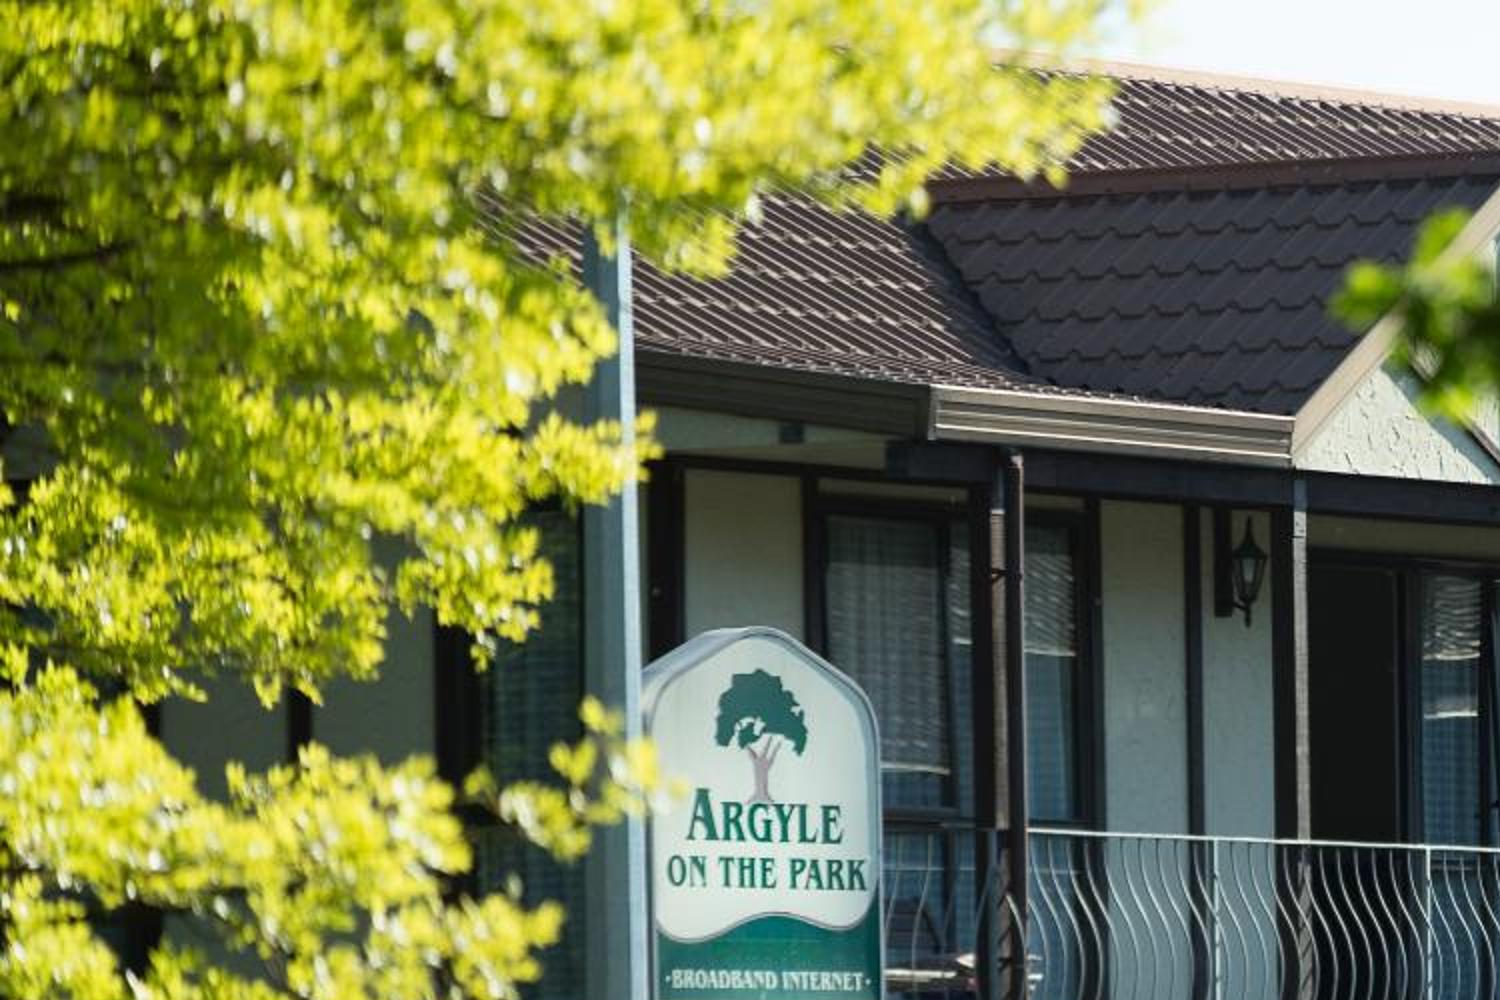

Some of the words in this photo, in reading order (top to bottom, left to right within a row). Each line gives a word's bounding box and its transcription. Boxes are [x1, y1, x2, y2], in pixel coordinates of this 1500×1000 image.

[686, 788, 844, 844] ARGYLE
[667, 855, 707, 887] ON
[718, 857, 777, 889] THE
[789, 859, 867, 891] PARK
[671, 968, 777, 990] BROADBAND
[781, 970, 863, 991] INTERNET
